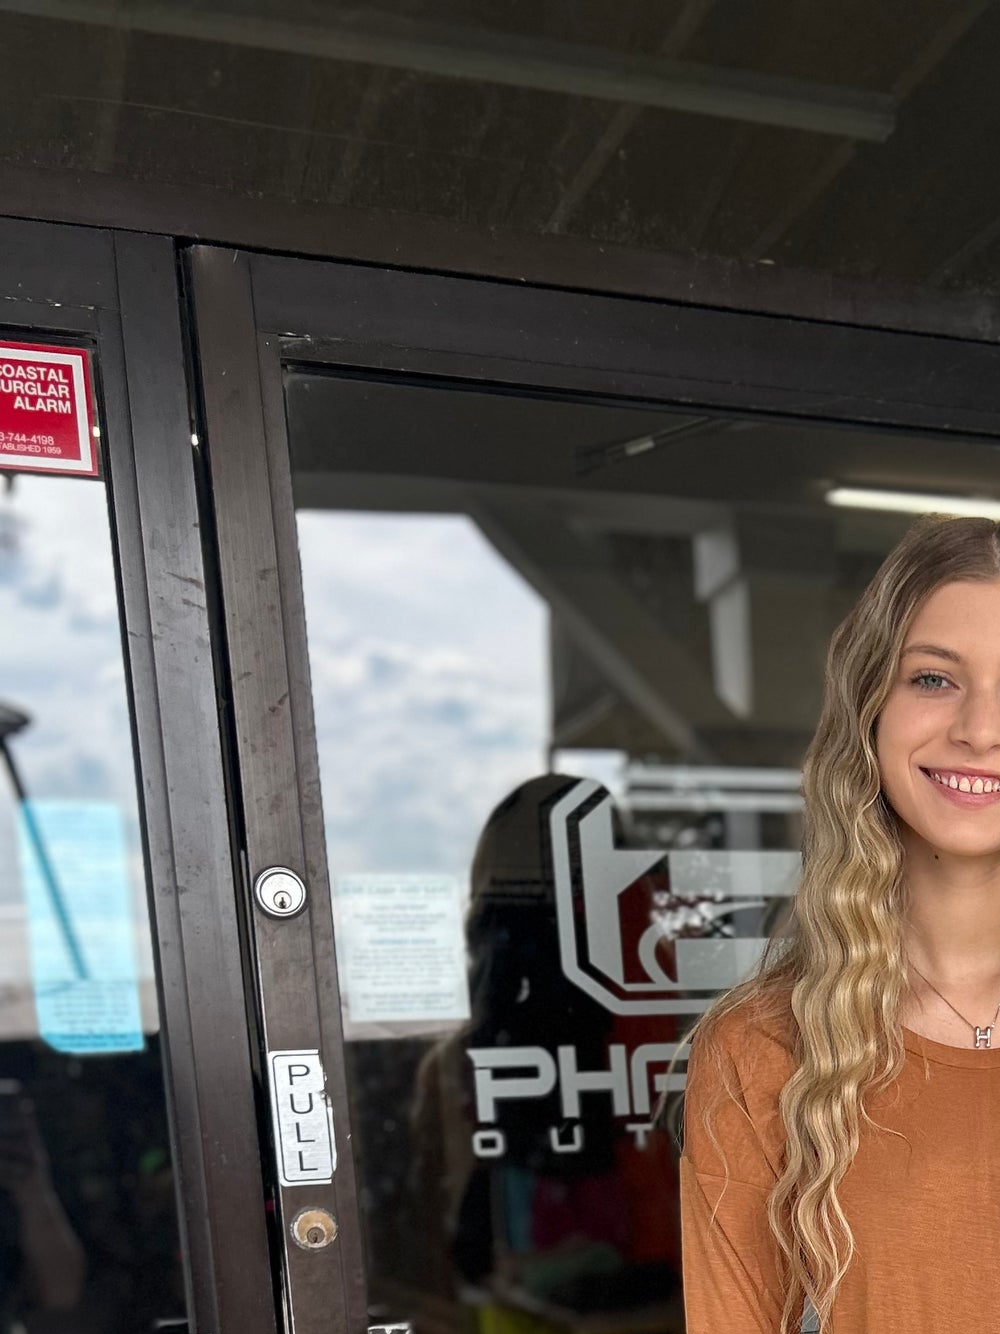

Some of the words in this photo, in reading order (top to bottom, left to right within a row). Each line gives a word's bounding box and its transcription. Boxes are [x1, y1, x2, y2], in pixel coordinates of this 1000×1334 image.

[0, 363, 69, 383] OASTAL
[0, 379, 70, 399] URGLAR
[13, 395, 72, 414] ALARM
[467, 1043, 689, 1123] PHA
[287, 1063, 319, 1173] PULL
[472, 1123, 655, 1158] OUT
